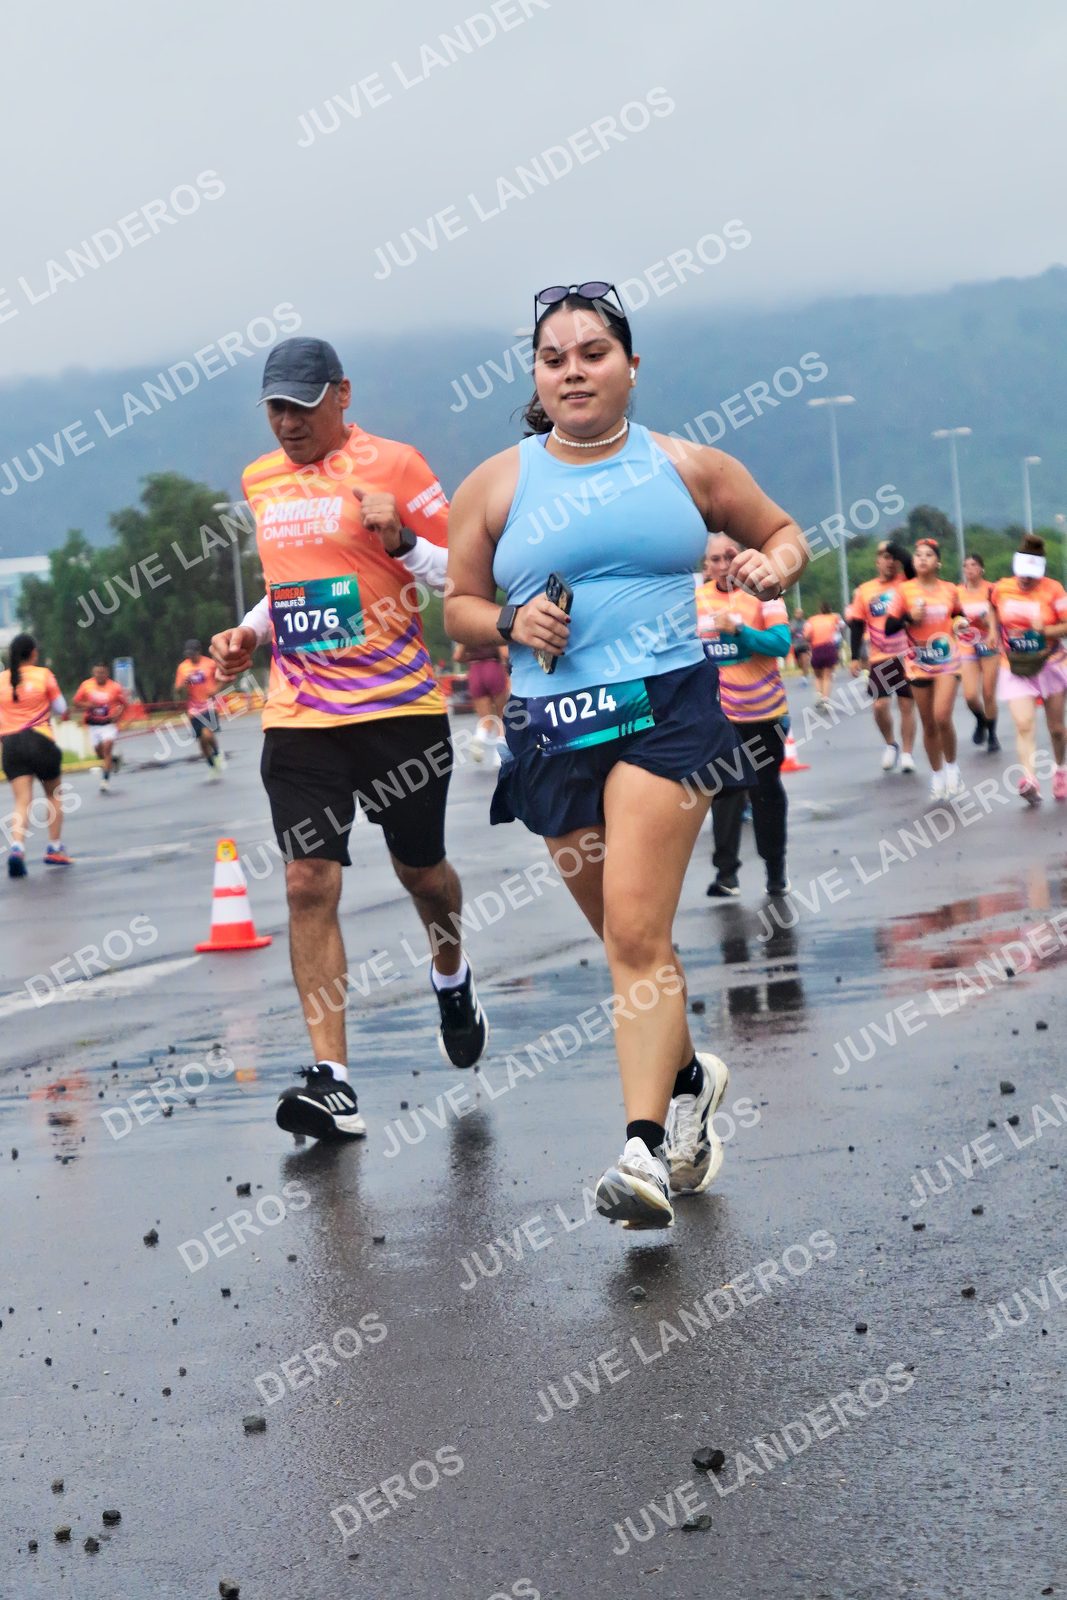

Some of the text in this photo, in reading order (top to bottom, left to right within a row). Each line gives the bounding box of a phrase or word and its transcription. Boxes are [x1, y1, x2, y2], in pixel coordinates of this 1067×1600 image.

[263, 521, 321, 540] OMNILIFE
[331, 580, 350, 596] 10K
[283, 608, 340, 633] 1076
[706, 643, 738, 656] 1039
[544, 688, 617, 728] 1024
